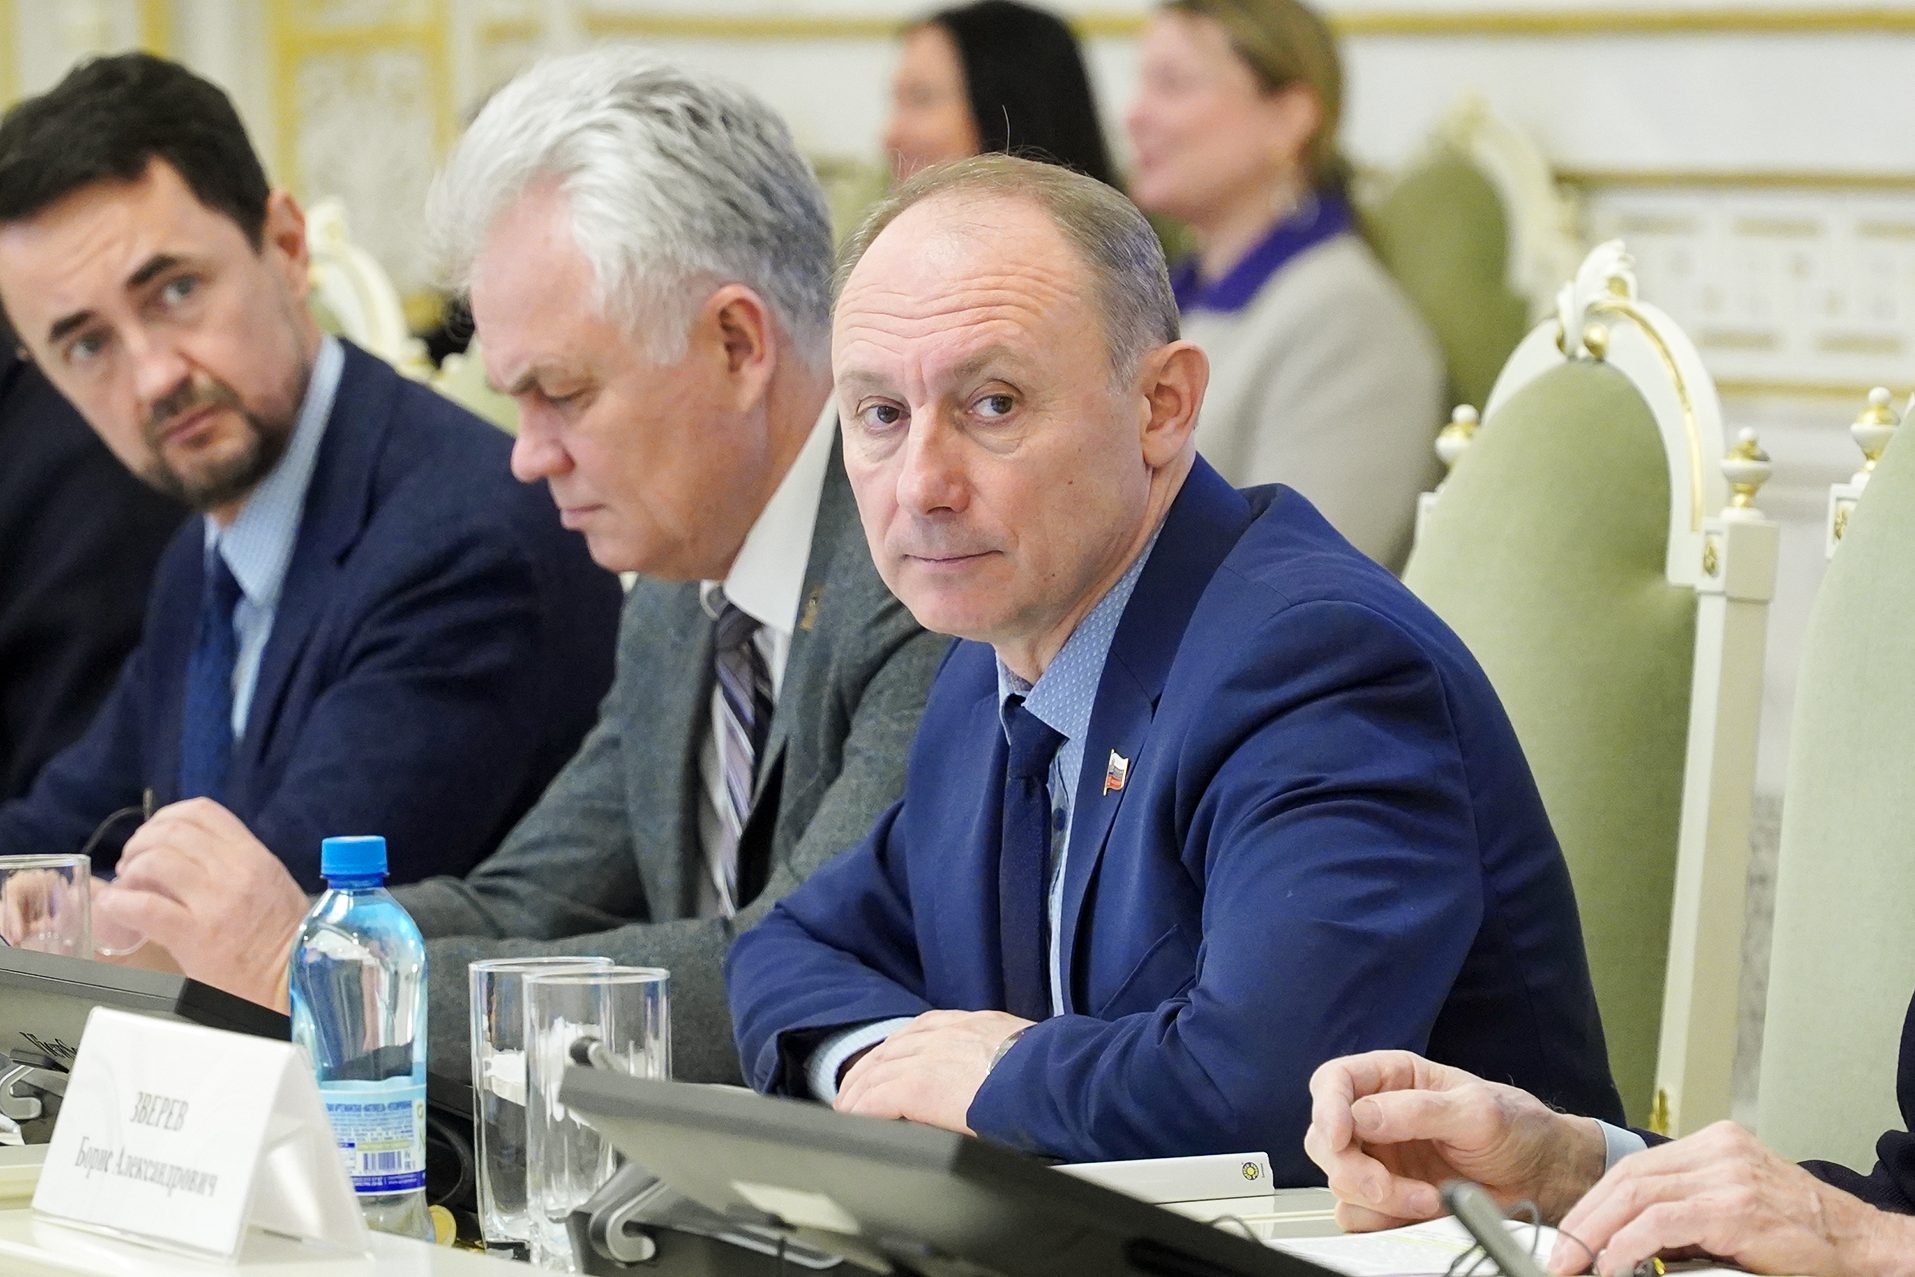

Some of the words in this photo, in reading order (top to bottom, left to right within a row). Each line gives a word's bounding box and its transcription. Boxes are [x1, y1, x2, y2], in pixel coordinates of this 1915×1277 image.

[130, 1091, 190, 1132] ЗВЕРЕВ
[75, 1136, 115, 1179] Борис
[114, 1145, 219, 1197] Александрович
